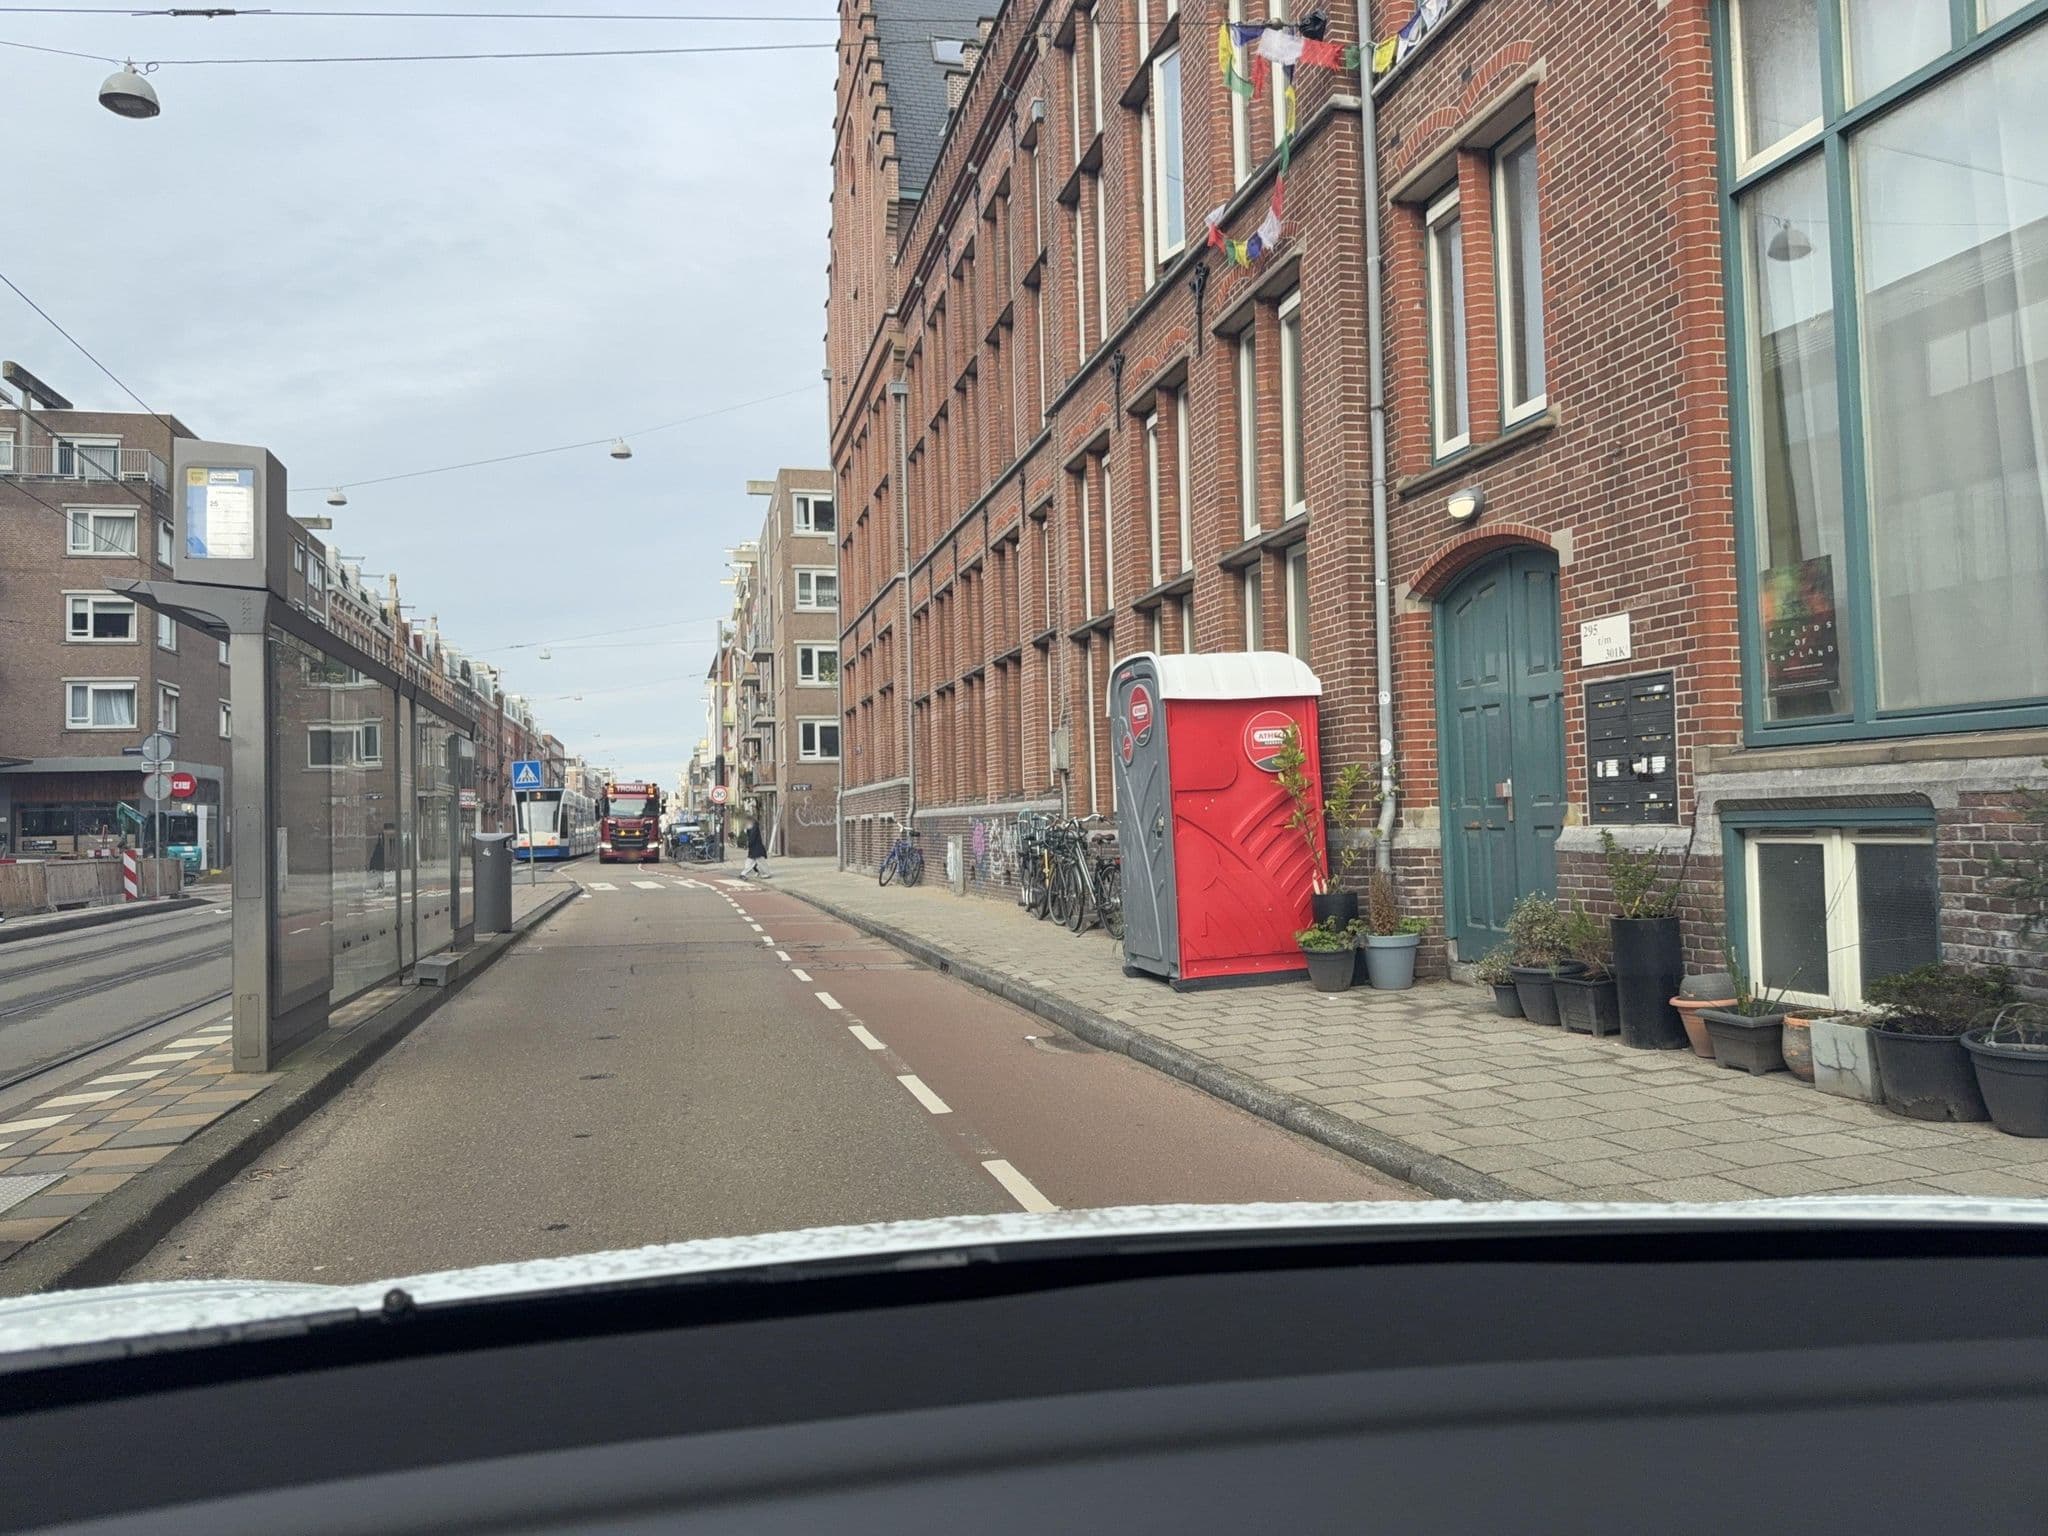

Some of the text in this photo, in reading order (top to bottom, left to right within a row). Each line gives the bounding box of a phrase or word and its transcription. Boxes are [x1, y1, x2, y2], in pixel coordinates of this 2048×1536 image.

[1583, 623, 1598, 637] 295
[1769, 621, 1832, 639] FIELDS
[1795, 637, 1808, 646] OF
[1770, 645, 1834, 661] ENGLAND
[616, 785, 647, 793] TROMAR
